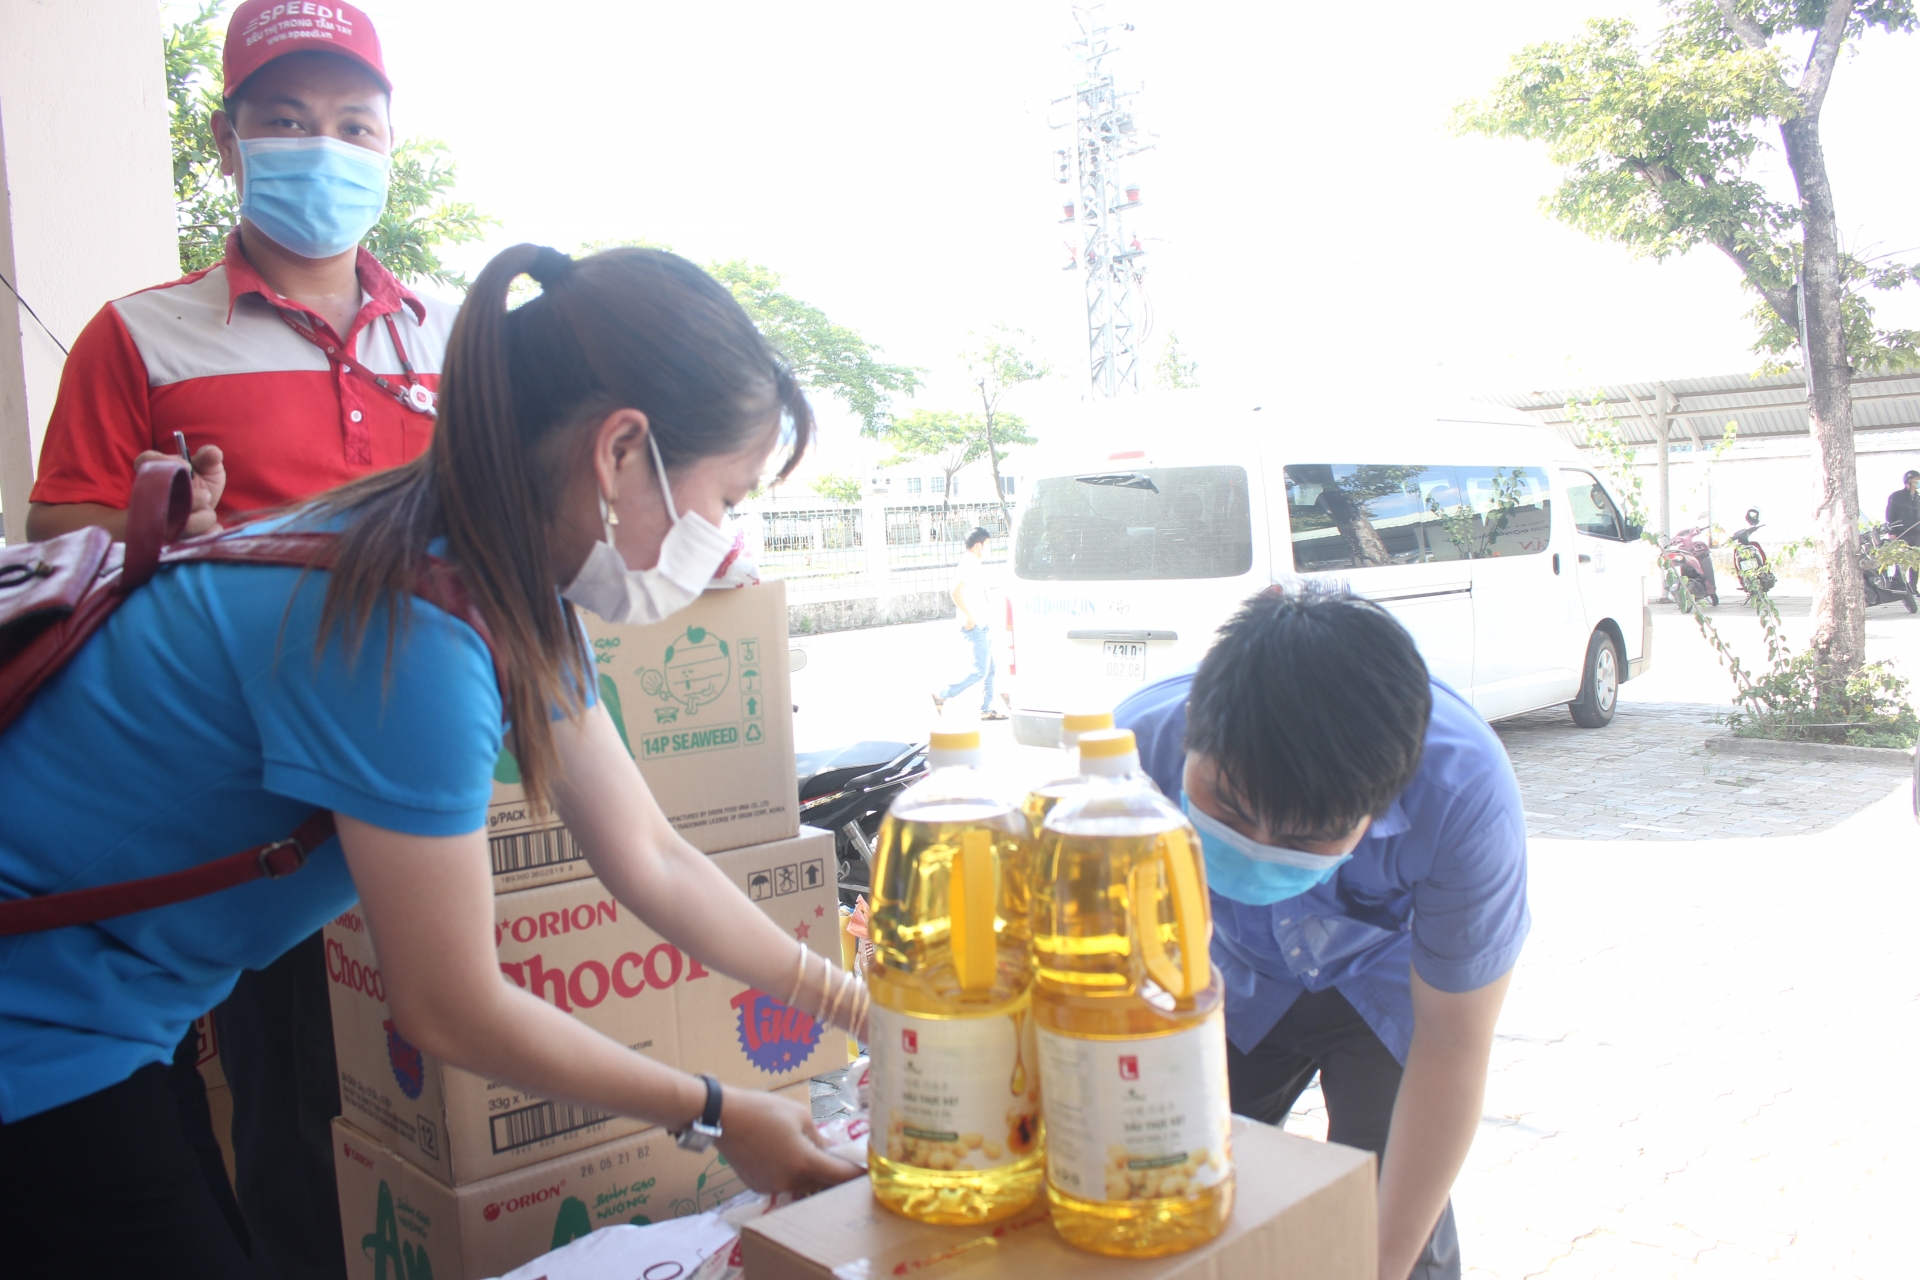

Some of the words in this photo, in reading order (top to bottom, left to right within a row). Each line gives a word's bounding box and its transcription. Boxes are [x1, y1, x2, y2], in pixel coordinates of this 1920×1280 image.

[246, 31, 263, 46] SIÊU
[278, 18, 313, 29] TRONG
[335, 24, 352, 36] TAY
[267, 29, 333, 45] www.speedl.vn
[1112, 644, 1137, 660] 43LD
[1107, 663, 1140, 677] 002.08
[644, 736, 669, 755] 14P
[672, 727, 737, 751] SEAWEED
[511, 898, 617, 943] ORION
[488, 1097, 510, 1111] 33g
[513, 1095, 520, 1105] x
[421, 1124, 434, 1151] 12
[618, 1152, 630, 1165] 21
[637, 1146, 650, 1159] B2
[506, 1184, 561, 1212] ORION
